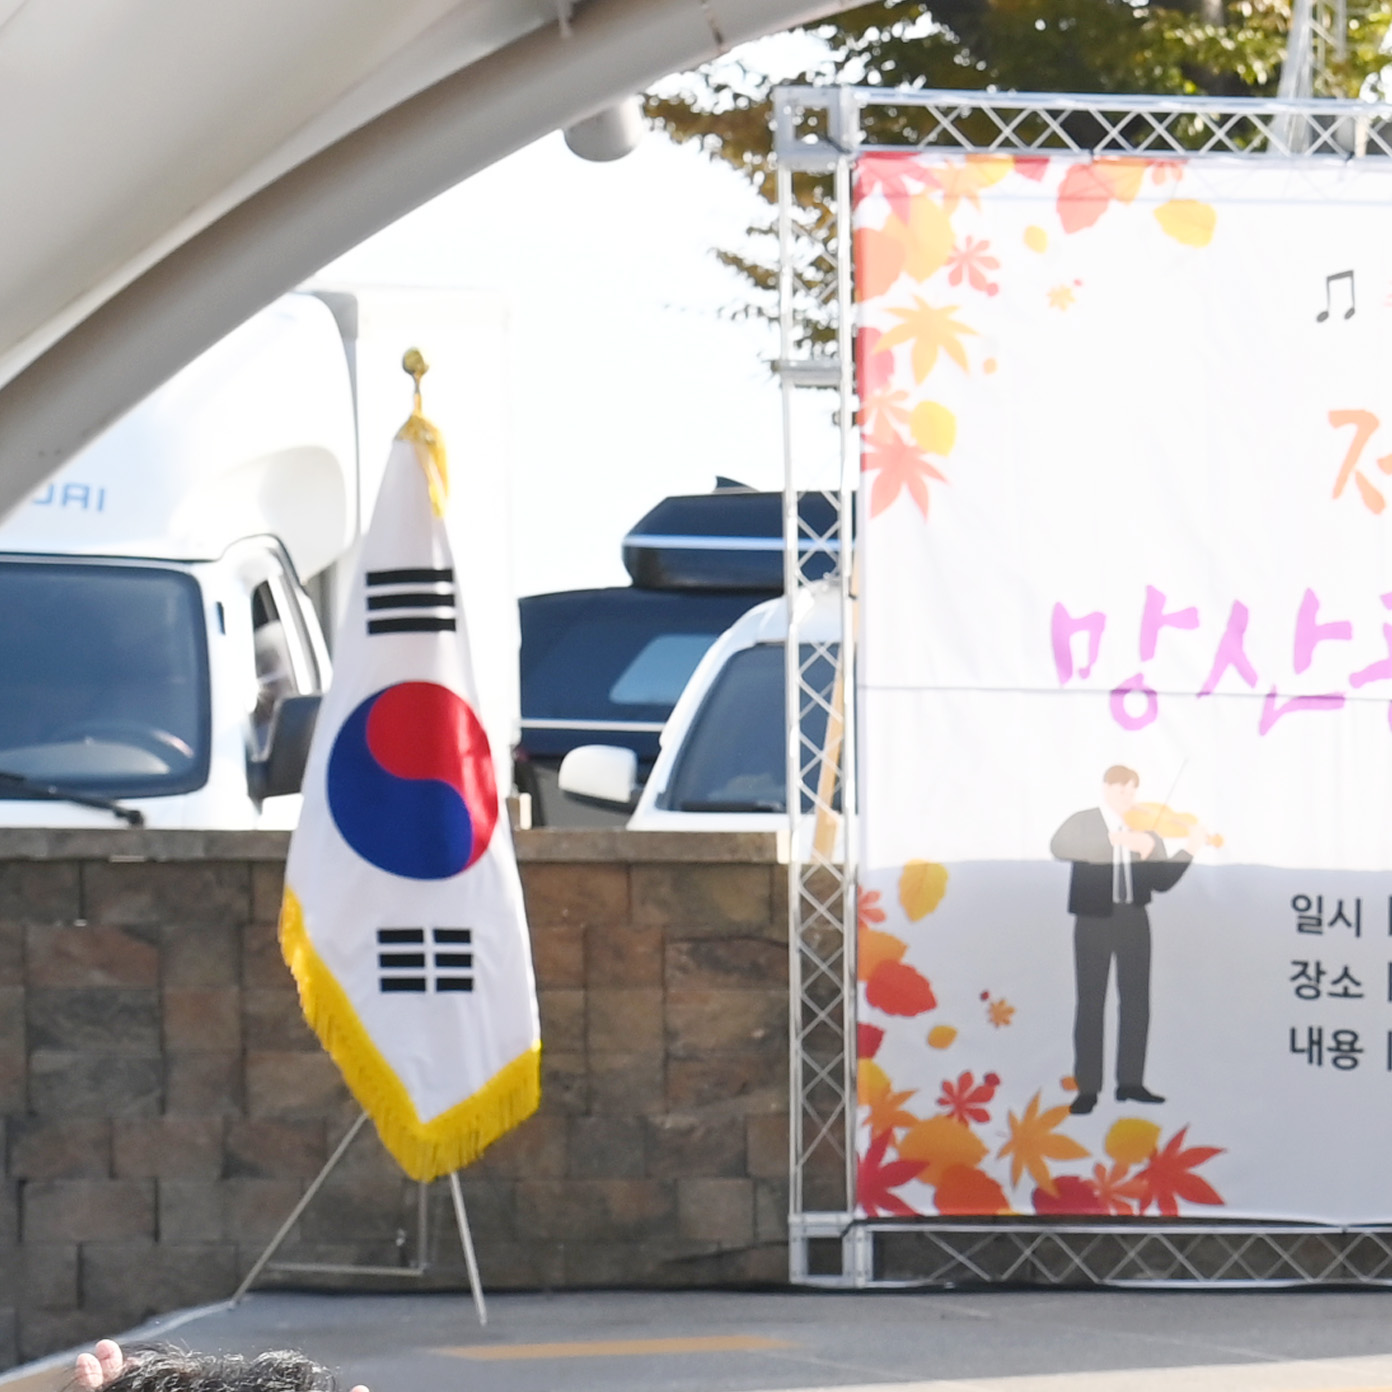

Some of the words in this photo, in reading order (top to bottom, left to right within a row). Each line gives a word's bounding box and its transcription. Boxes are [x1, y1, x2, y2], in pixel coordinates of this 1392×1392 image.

[1290, 894, 1362, 937] 일시
[1289, 960, 1365, 1001] 장소
[1289, 1026, 1365, 1071] 내용
